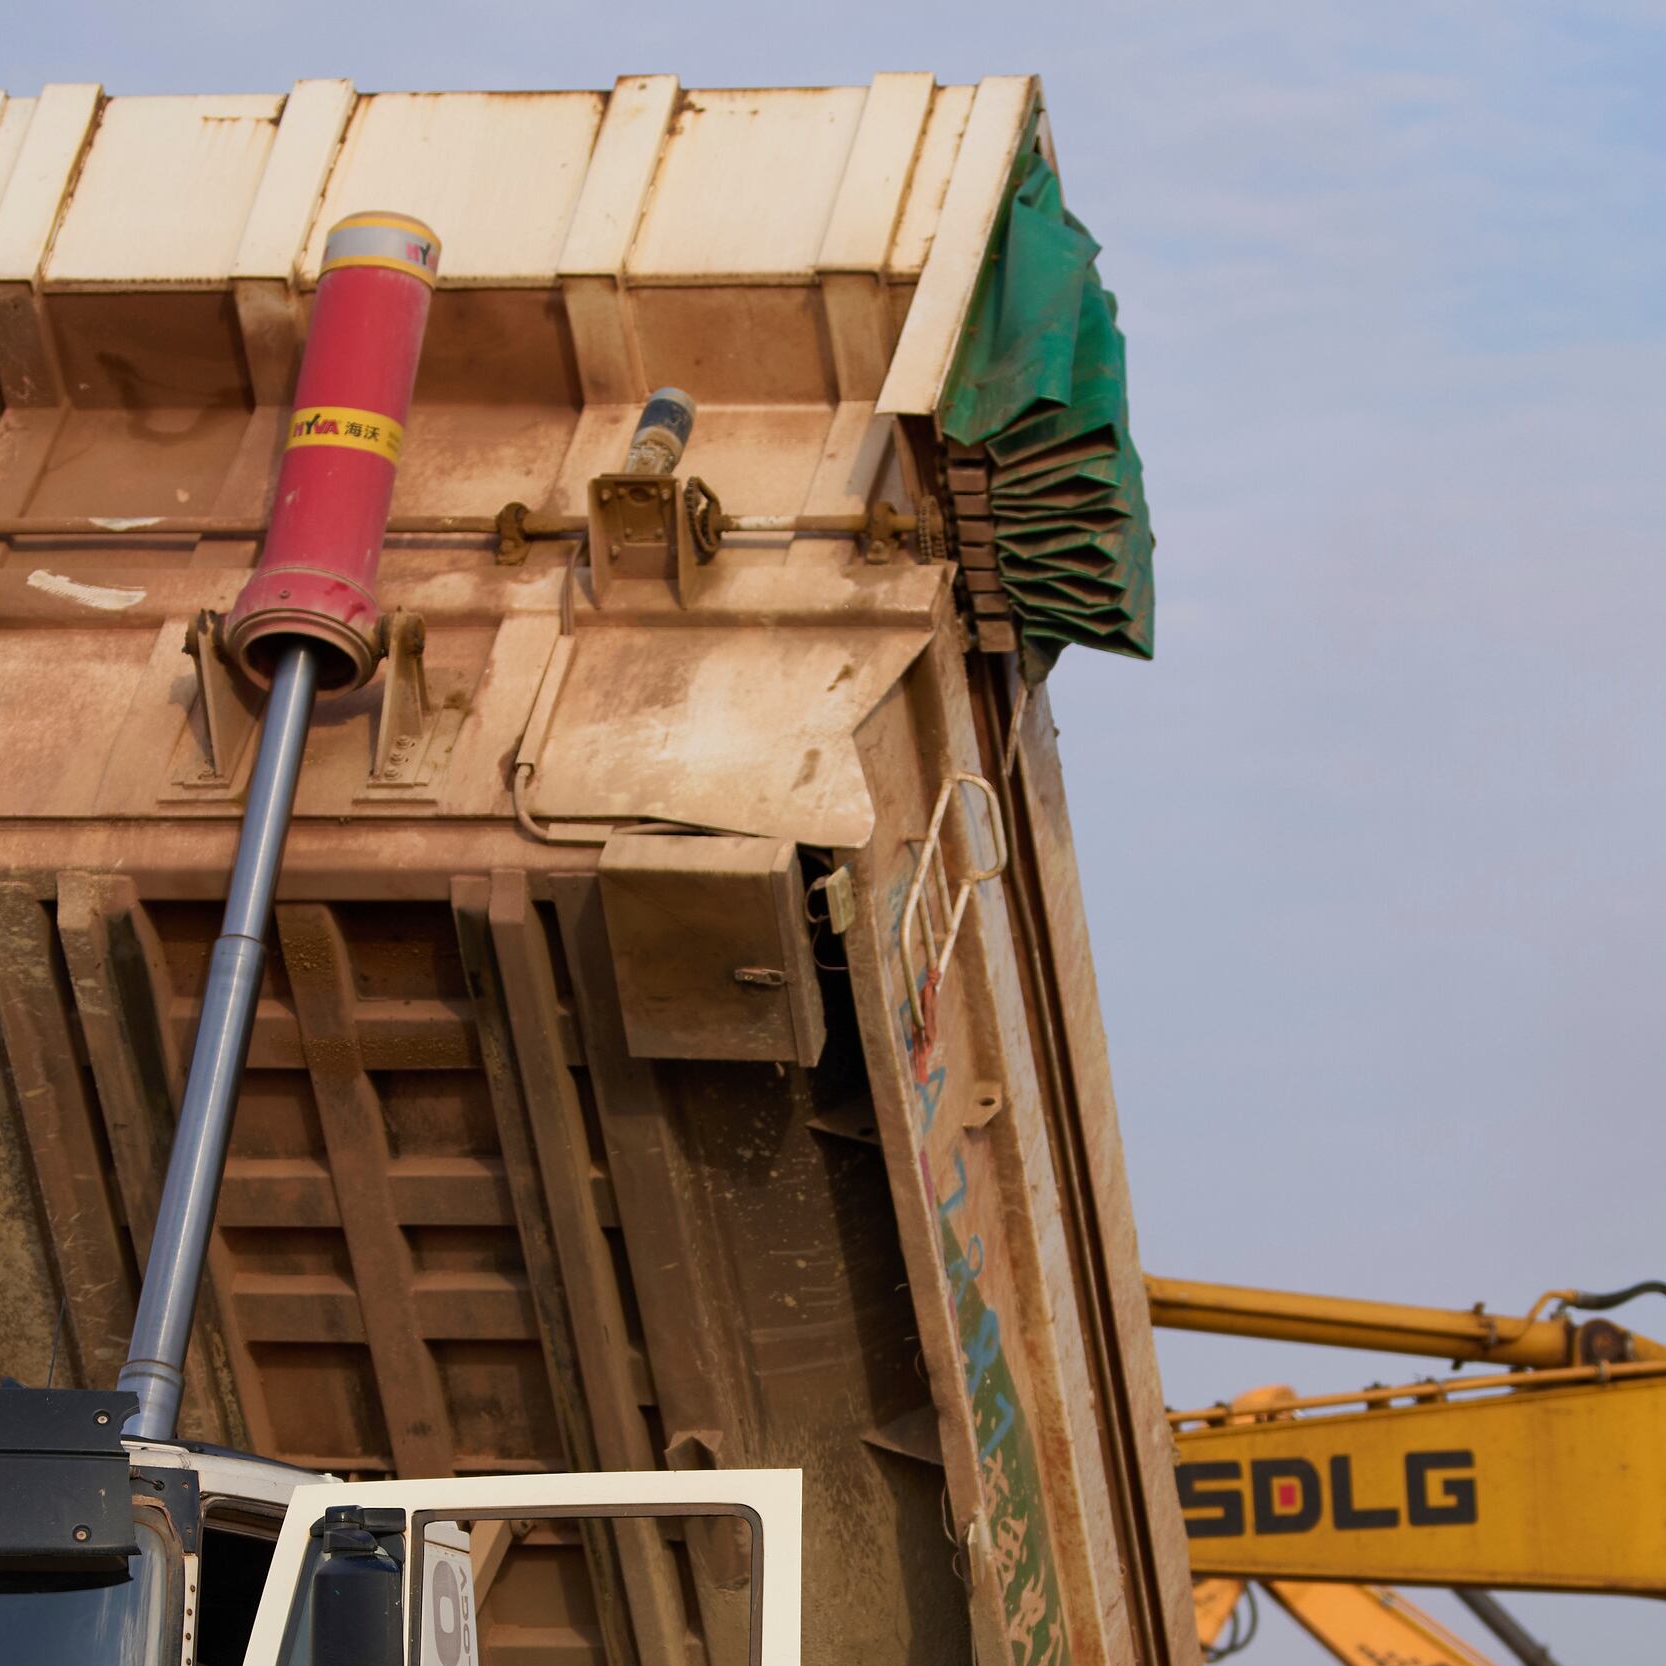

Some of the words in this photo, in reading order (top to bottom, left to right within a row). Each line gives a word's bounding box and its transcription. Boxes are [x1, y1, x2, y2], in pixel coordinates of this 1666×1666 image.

[292, 413, 339, 438] HYVA
[344, 420, 381, 442] 海沃
[1175, 1450, 1477, 1538] SDLG
